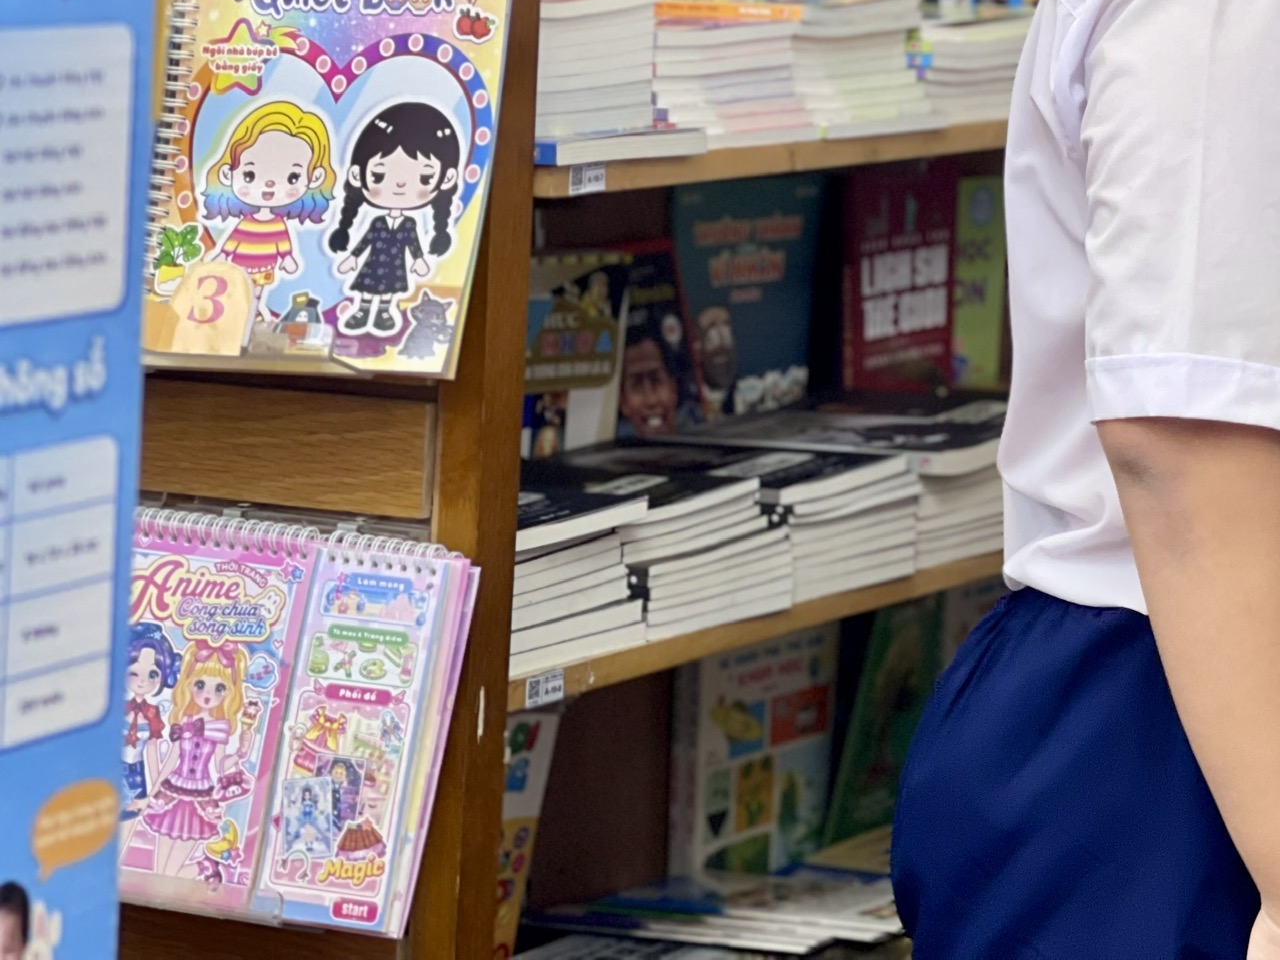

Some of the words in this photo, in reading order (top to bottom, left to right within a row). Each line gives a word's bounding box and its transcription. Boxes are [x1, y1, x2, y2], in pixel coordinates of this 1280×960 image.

[187, 275, 228, 324] 3
[131, 559, 241, 615] Anime
[240, 564, 268, 589] TRANG
[339, 688, 361, 700] Phối
[318, 855, 385, 886] Magic
[341, 903, 369, 918] start
